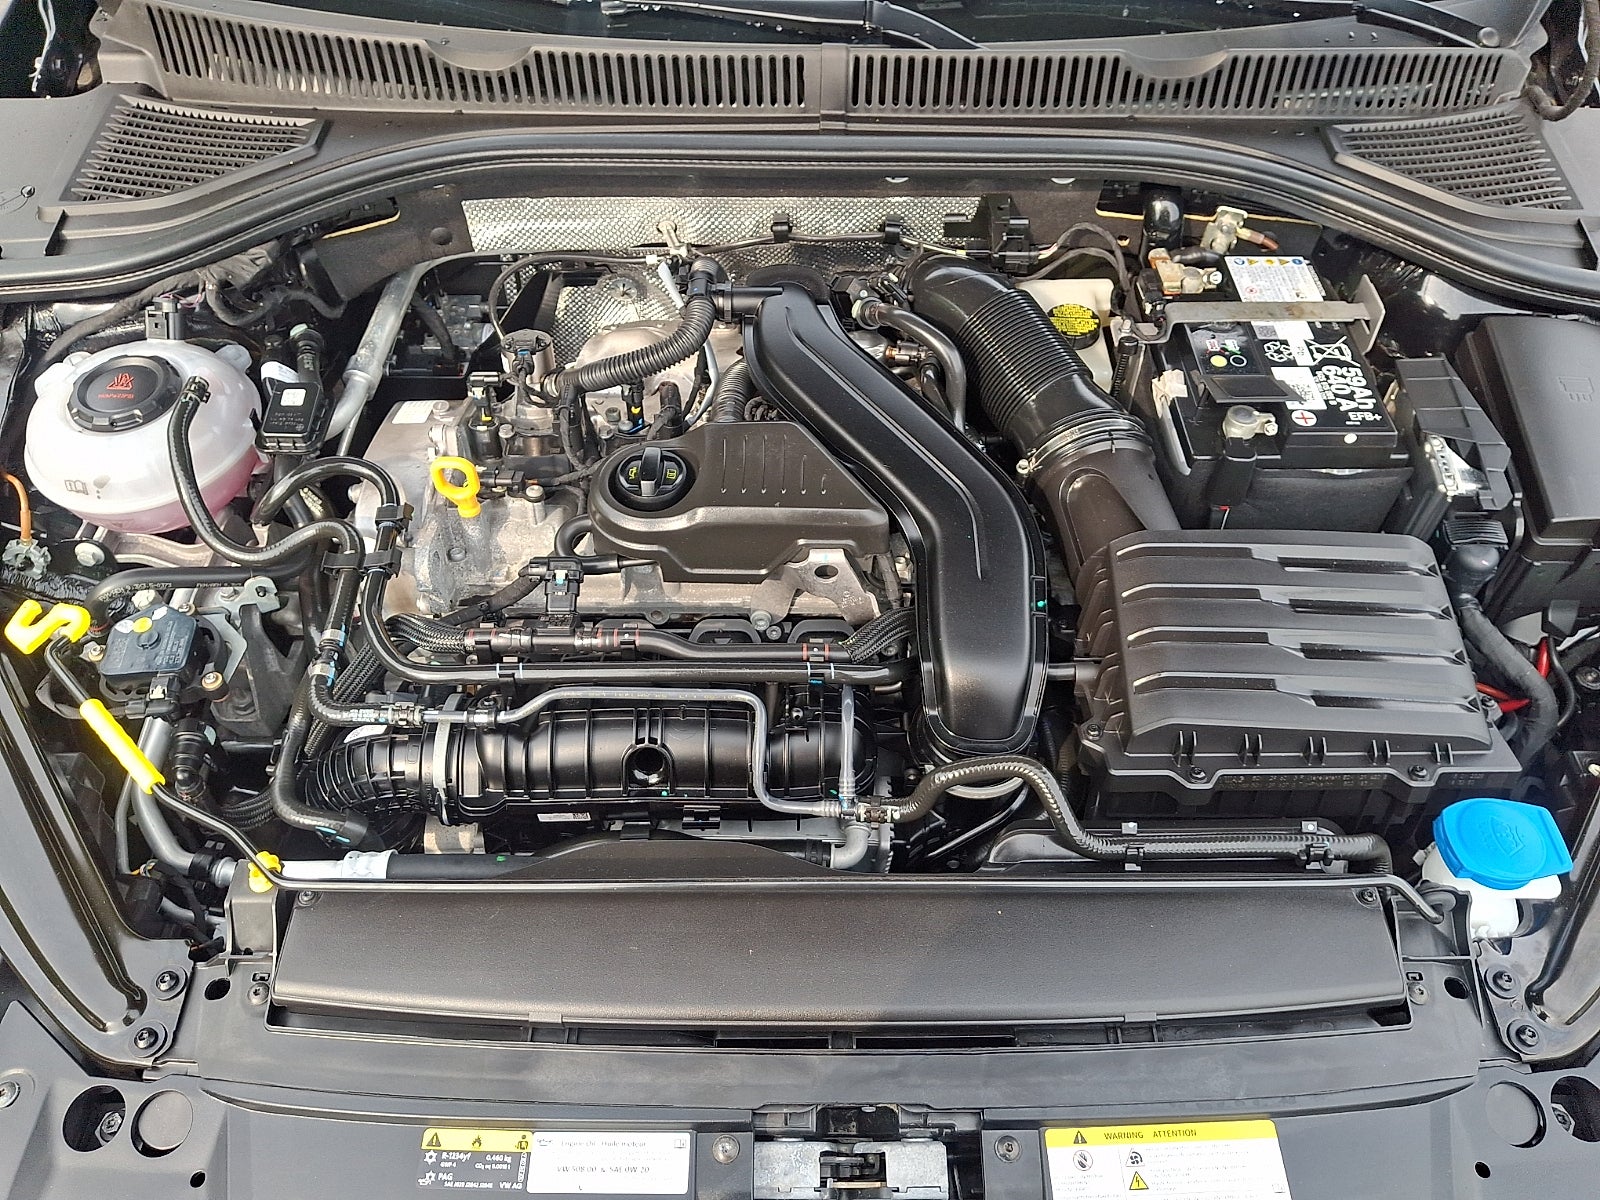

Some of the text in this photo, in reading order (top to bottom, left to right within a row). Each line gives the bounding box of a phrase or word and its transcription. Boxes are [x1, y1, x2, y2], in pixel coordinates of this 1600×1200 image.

[1321, 365, 1352, 395] 640
[1342, 366, 1376, 410] 59Ah
[1335, 397, 1359, 412] A
[1347, 411, 1383, 421] EFB+
[1103, 1128, 1197, 1140] WARNING ATTENTION
[437, 1172, 454, 1181] PAG
